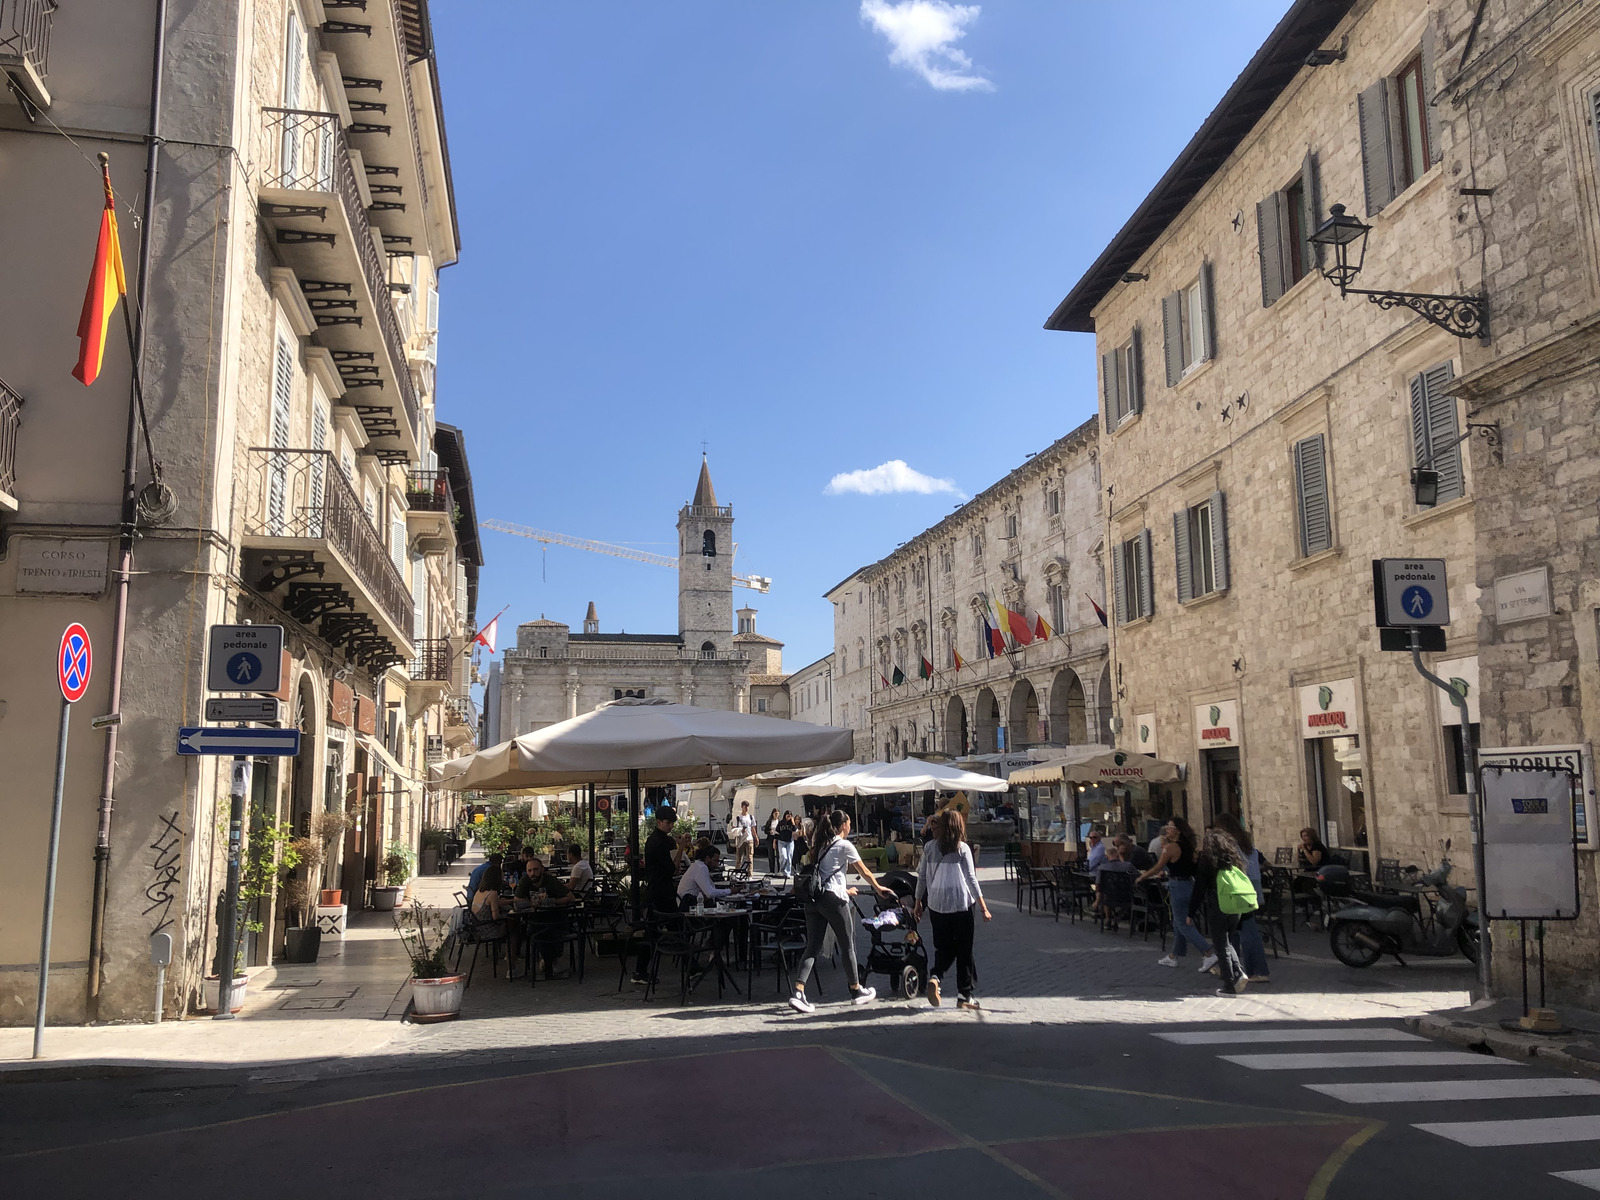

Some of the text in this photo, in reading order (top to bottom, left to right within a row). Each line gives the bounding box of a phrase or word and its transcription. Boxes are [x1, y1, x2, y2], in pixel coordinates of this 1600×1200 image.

[41, 550, 85, 560] CORSO
[22, 567, 60, 577] TRENTO
[67, 568, 103, 578] TRIESTE
[1394, 573, 1436, 582] pedonale
[223, 641, 268, 650] pedonale
[1307, 711, 1348, 728] MIGLIORI
[1201, 727, 1232, 742] MIGLIORI
[1509, 756, 1575, 772] ROBLES
[1099, 767, 1144, 779] MIGLIORI
